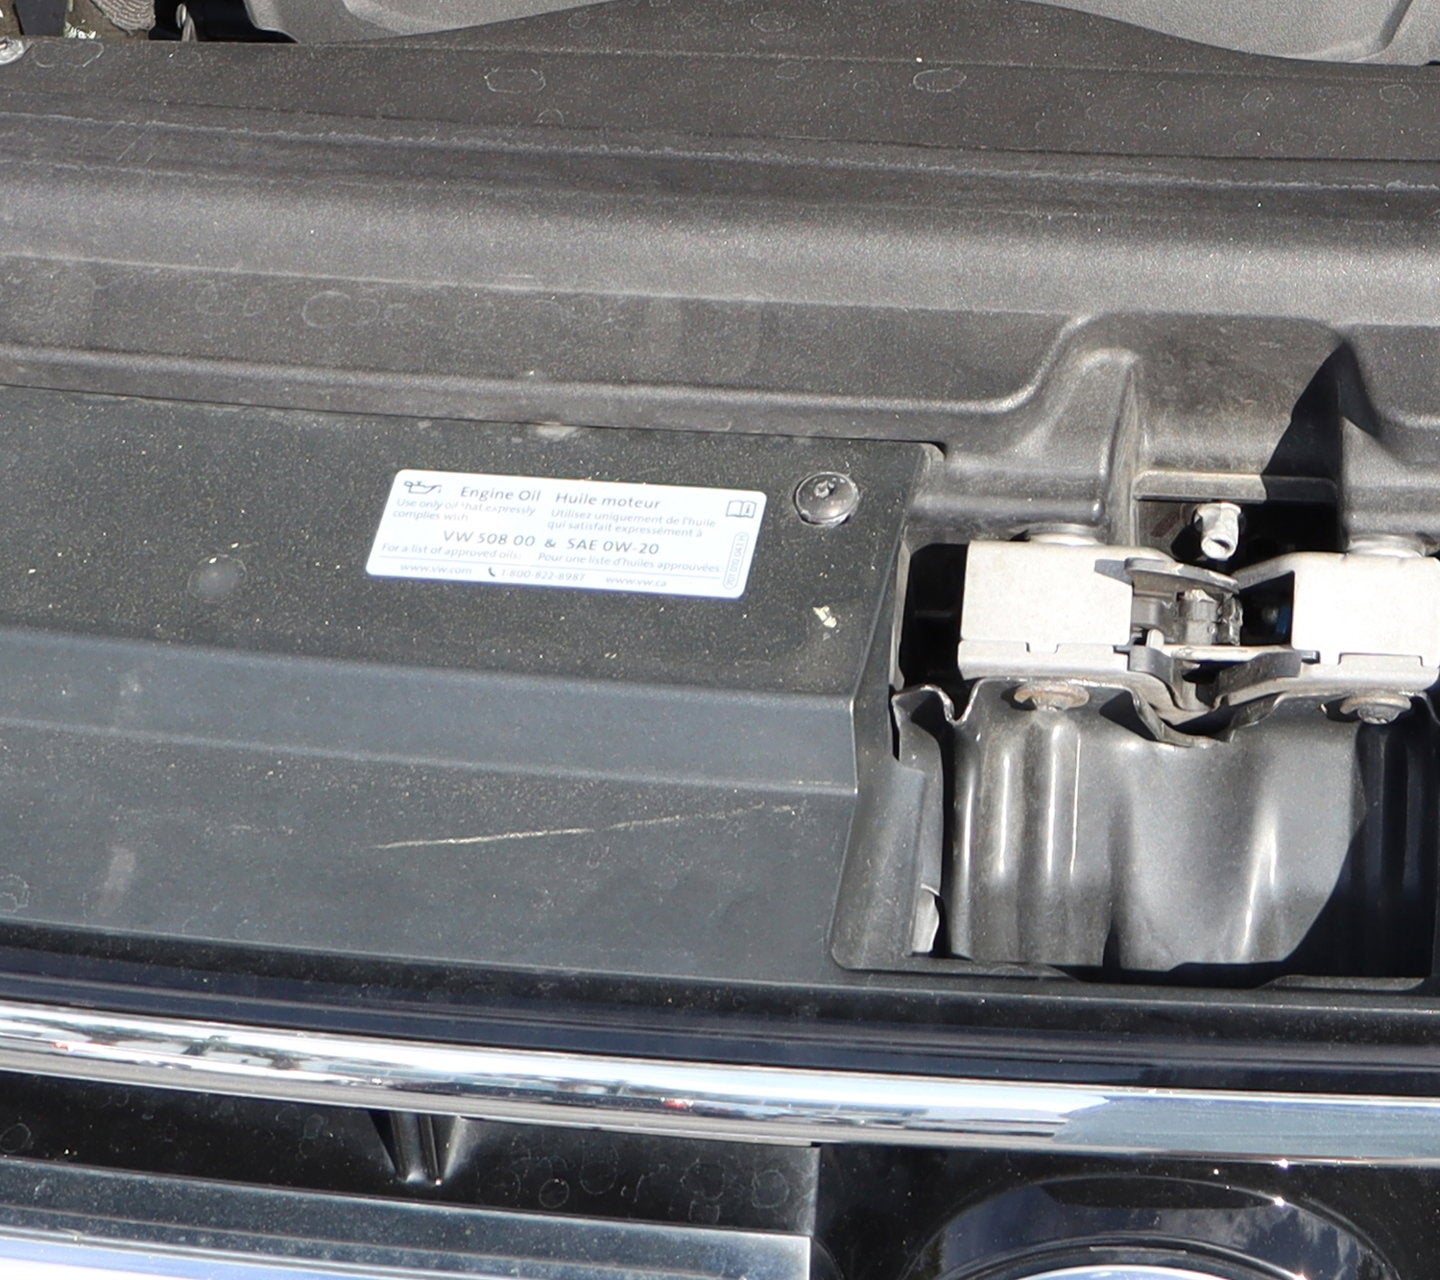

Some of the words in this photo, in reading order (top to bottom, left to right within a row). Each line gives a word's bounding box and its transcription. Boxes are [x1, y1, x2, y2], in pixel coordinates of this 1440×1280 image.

[460, 486, 515, 502] Engine
[518, 490, 542, 501] Oil
[555, 493, 597, 505] Huile
[601, 497, 661, 509] moteur
[594, 512, 663, 525] uniquement
[666, 514, 679, 525] de
[382, 543, 399, 552] For
[443, 530, 474, 542] VW
[477, 533, 508, 545] 508
[513, 535, 536, 547] 00
[544, 539, 556, 548] &
[567, 539, 597, 551] SAE
[538, 553, 563, 563] Pour
[565, 555, 586, 564] une
[589, 555, 610, 566] liste
